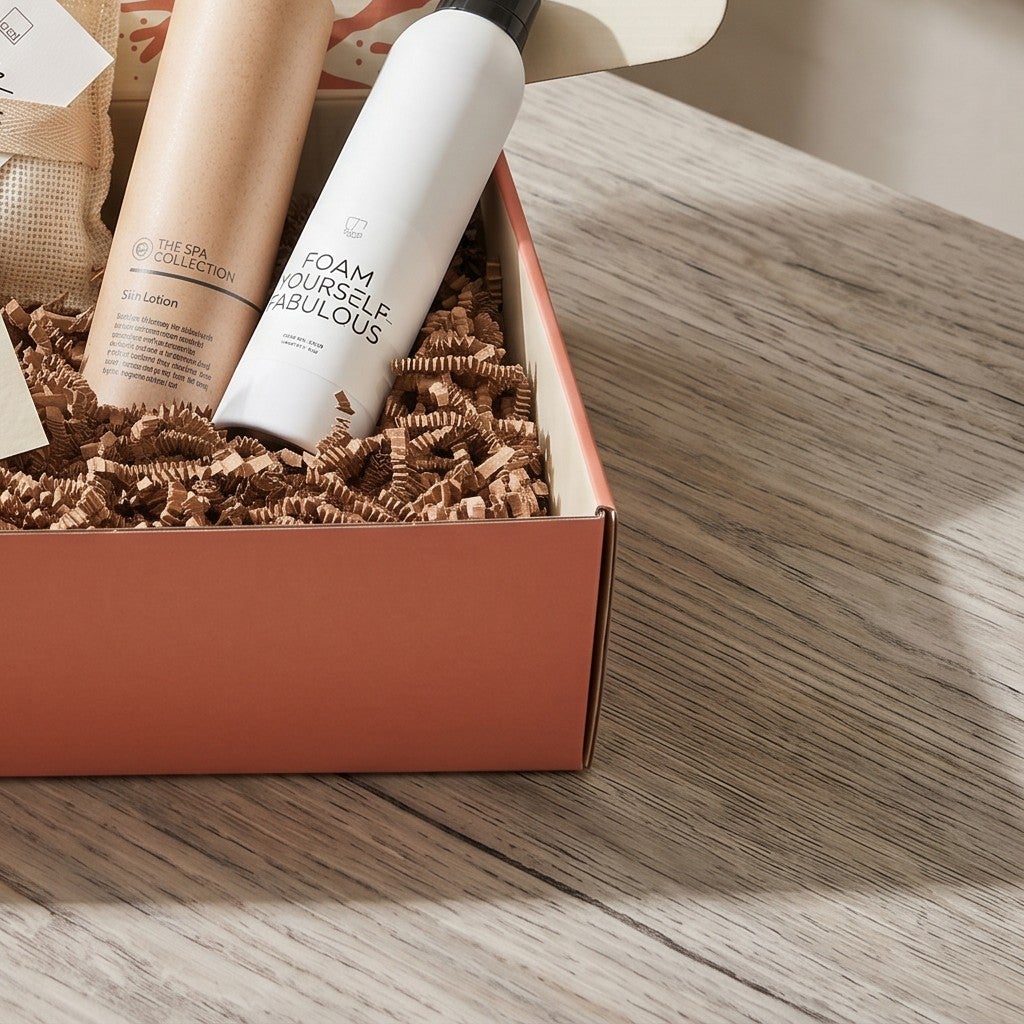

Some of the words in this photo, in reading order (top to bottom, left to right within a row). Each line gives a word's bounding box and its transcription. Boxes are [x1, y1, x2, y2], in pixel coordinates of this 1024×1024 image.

[158, 238, 183, 253] THE
[183, 243, 208, 260] SPA
[154, 251, 236, 283] COLLECTION
[302, 252, 375, 288] FOAM
[143, 291, 179, 309] Lotion
[266, 293, 382, 345] FABULOUS
